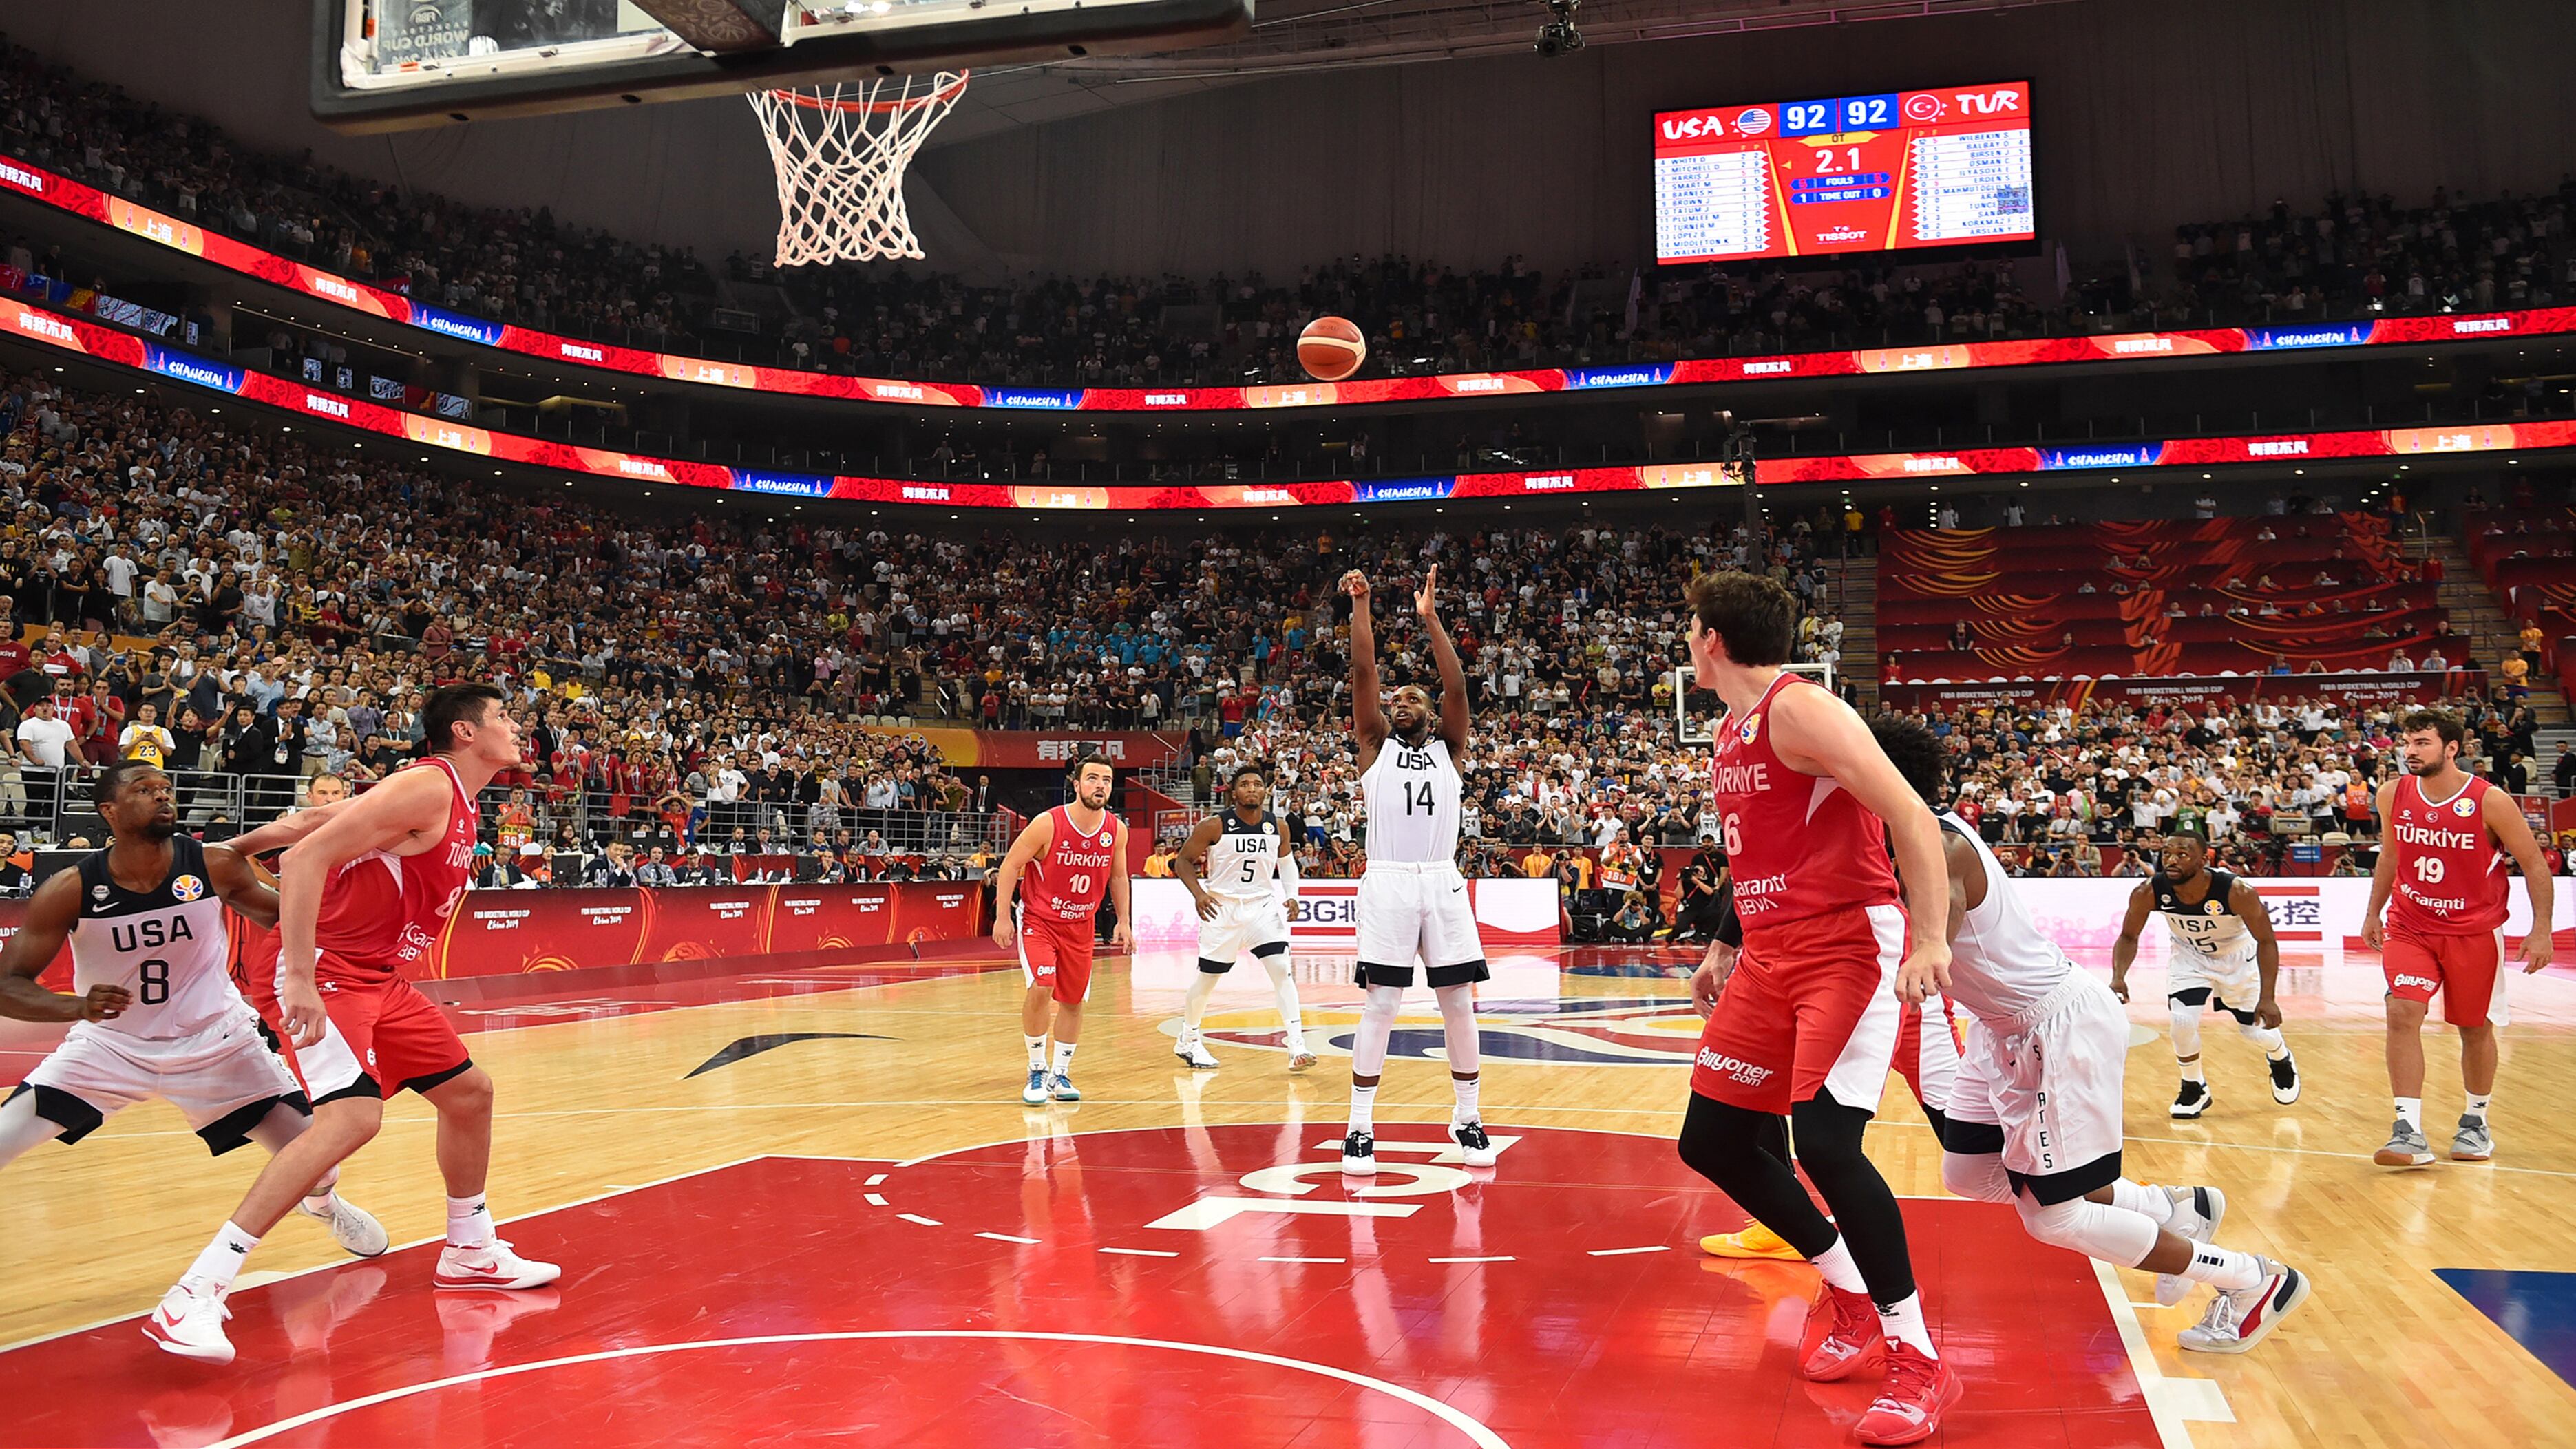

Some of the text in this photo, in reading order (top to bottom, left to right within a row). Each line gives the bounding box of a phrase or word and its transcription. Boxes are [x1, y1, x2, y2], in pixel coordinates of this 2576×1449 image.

[1955, 90, 2019, 115] TUR
[1787, 105, 1826, 130] 92
[1848, 99, 1887, 125] 92
[1662, 116, 1724, 140] USA
[1832, 134, 1845, 142] OT
[1815, 147, 1859, 173] 2.1
[1799, 175, 1882, 188] 5 FOULS 5
[1800, 189, 1881, 202] 1 TIME OUT 0
[142, 219, 172, 243] 上海
[1816, 231, 1867, 241] TISSOT
[1674, 239, 1720, 247] MIDDLETON
[1898, 353, 1932, 370] 上海
[694, 366, 724, 384] 上海
[1278, 391, 1307, 406] 上海
[435, 429, 461, 449] 上海
[2434, 434, 2472, 452] 上海
[1678, 470, 1712, 487] 上海
[1046, 494, 1076, 508] 上海
[2181, 695, 2204, 704] 2019
[2376, 690, 2400, 699] 2019
[140, 745, 156, 757] 23
[1397, 752, 1437, 770] USA
[1713, 759, 1771, 794] ÜRKİYE
[1404, 781, 1435, 816] 14
[1465, 819, 1476, 827] 24
[1724, 812, 1743, 856] 6
[2394, 822, 2475, 850] TÜRKİYE
[1236, 838, 1267, 853] USA
[1055, 850, 1111, 867] TÜRKİYE
[1241, 860, 1256, 882] 5
[2414, 856, 2445, 884] 19
[1069, 874, 1091, 893] 10
[435, 885, 462, 918] 8
[1062, 900, 1095, 911] Garanti
[1735, 896, 1779, 916] BBVA
[2409, 890, 2465, 910] Garanti
[1059, 910, 1086, 920] BBVA
[2171, 917, 2217, 932] USA
[112, 915, 193, 953] USA
[2186, 935, 2218, 953] 15
[140, 960, 169, 1005] 8
[1696, 1046, 1774, 1080] Bilyoner
[1729, 1072, 1762, 1087] .com
